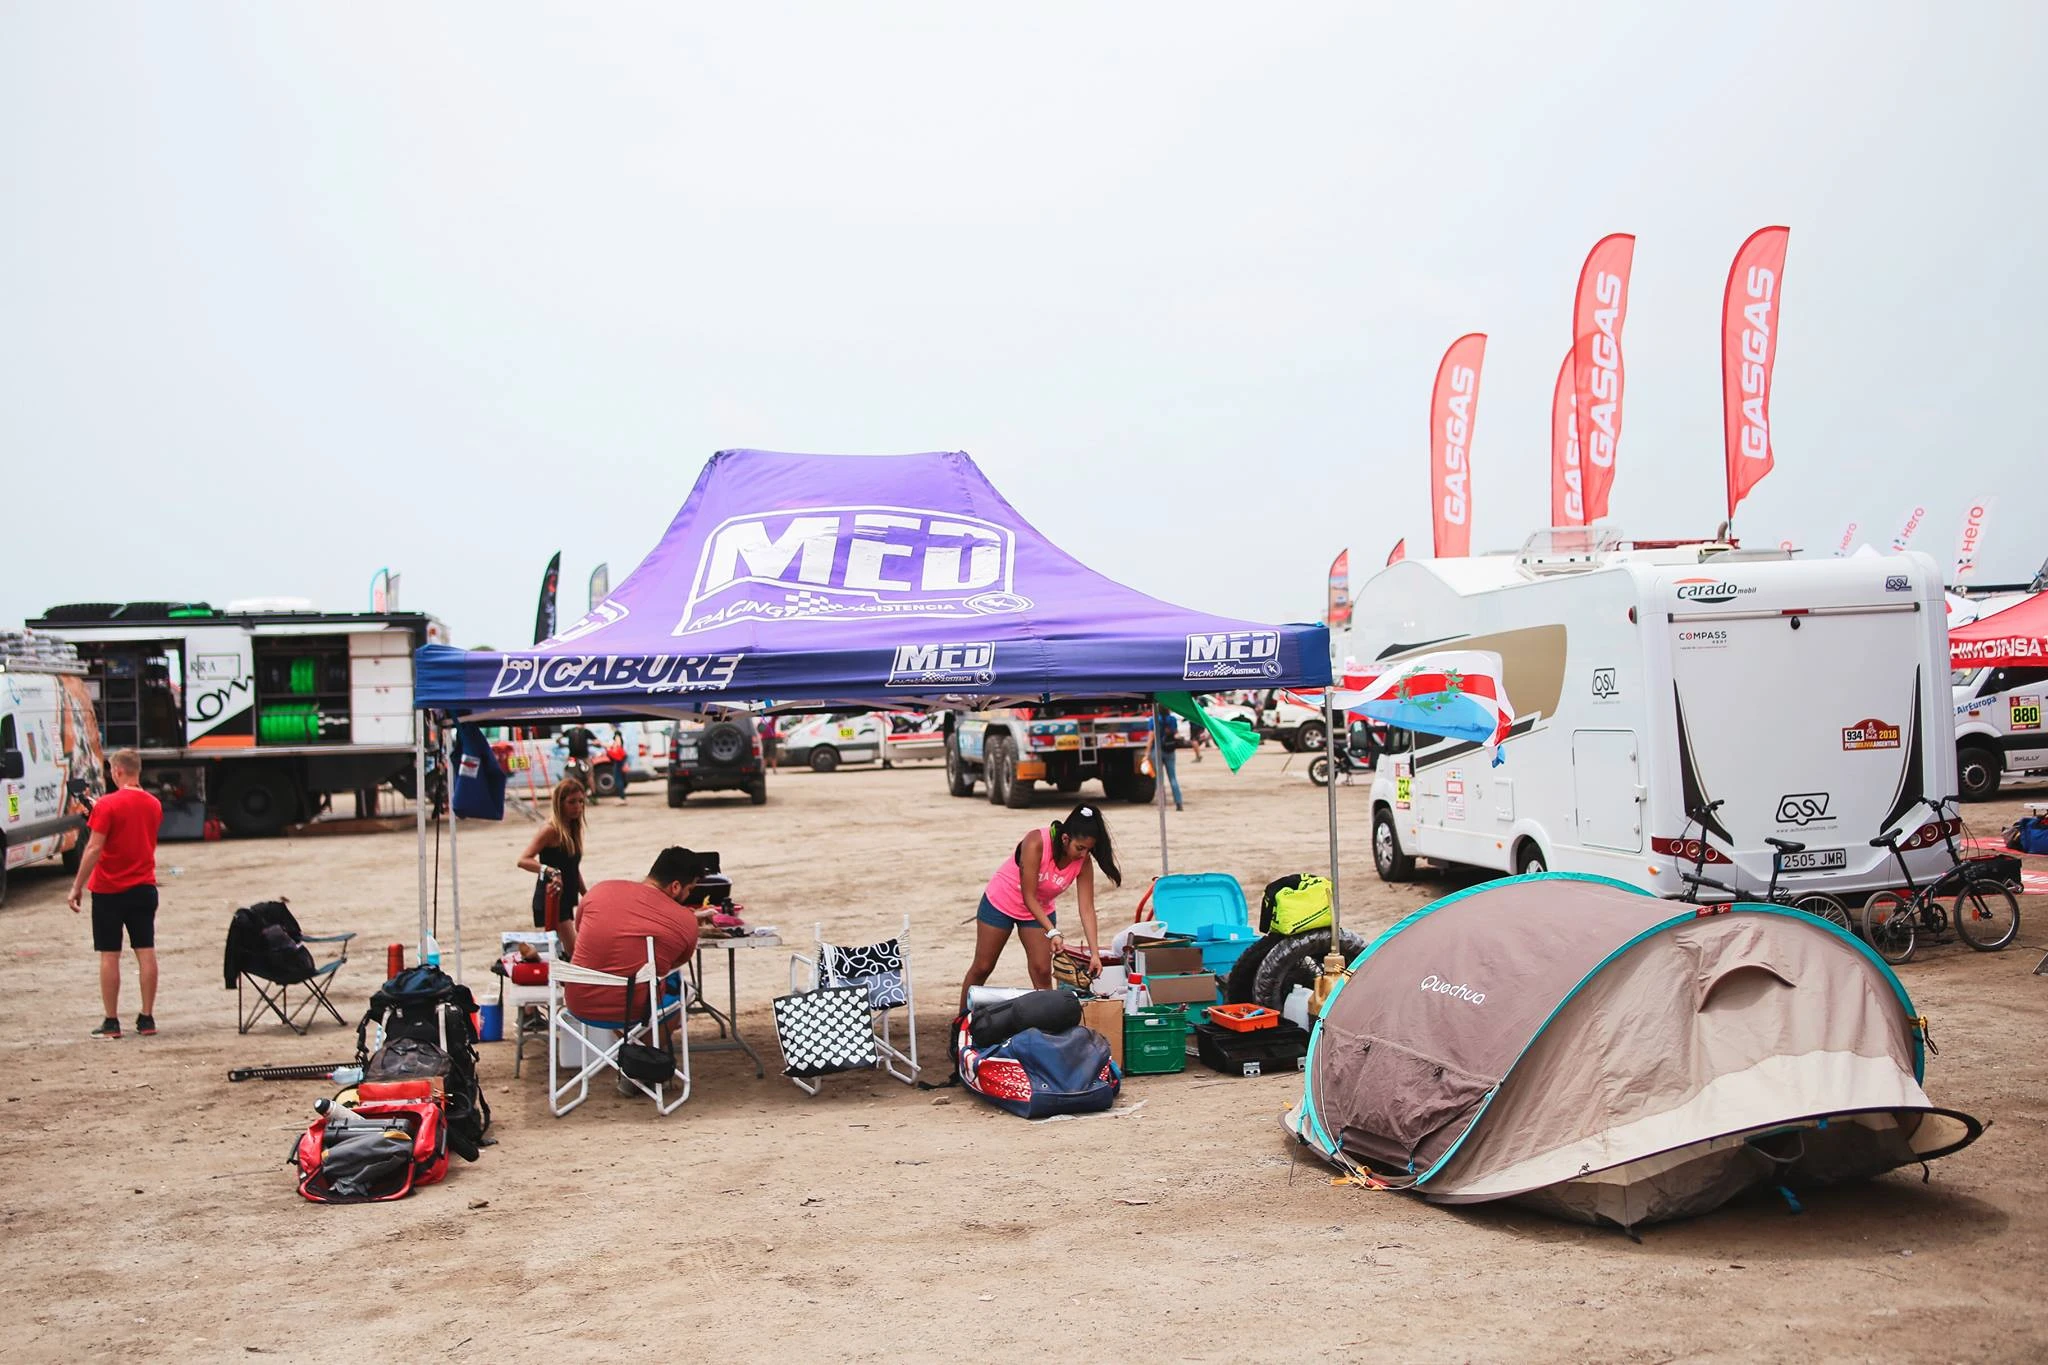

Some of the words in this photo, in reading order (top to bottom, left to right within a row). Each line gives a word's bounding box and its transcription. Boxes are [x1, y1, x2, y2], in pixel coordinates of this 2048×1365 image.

[1589, 271, 1622, 468] GASGAS
[1741, 265, 1775, 460] GASGAS
[1443, 364, 1476, 526] GASGAS
[1902, 507, 1925, 539] Hero
[1963, 506, 1984, 552] Hero
[704, 513, 1001, 592] MED
[897, 643, 991, 671] MED
[1190, 632, 1276, 660] MED
[1950, 638, 2042, 659] HIMOINSA
[538, 654, 744, 693] CABURE
[2013, 707, 2038, 723] 880
[1847, 731, 1863, 740] 934
[1879, 730, 1897, 739] 2018
[1784, 855, 1816, 868] 2505
[1820, 852, 1843, 865] JMR
[1420, 975, 1486, 1006] Quechua
